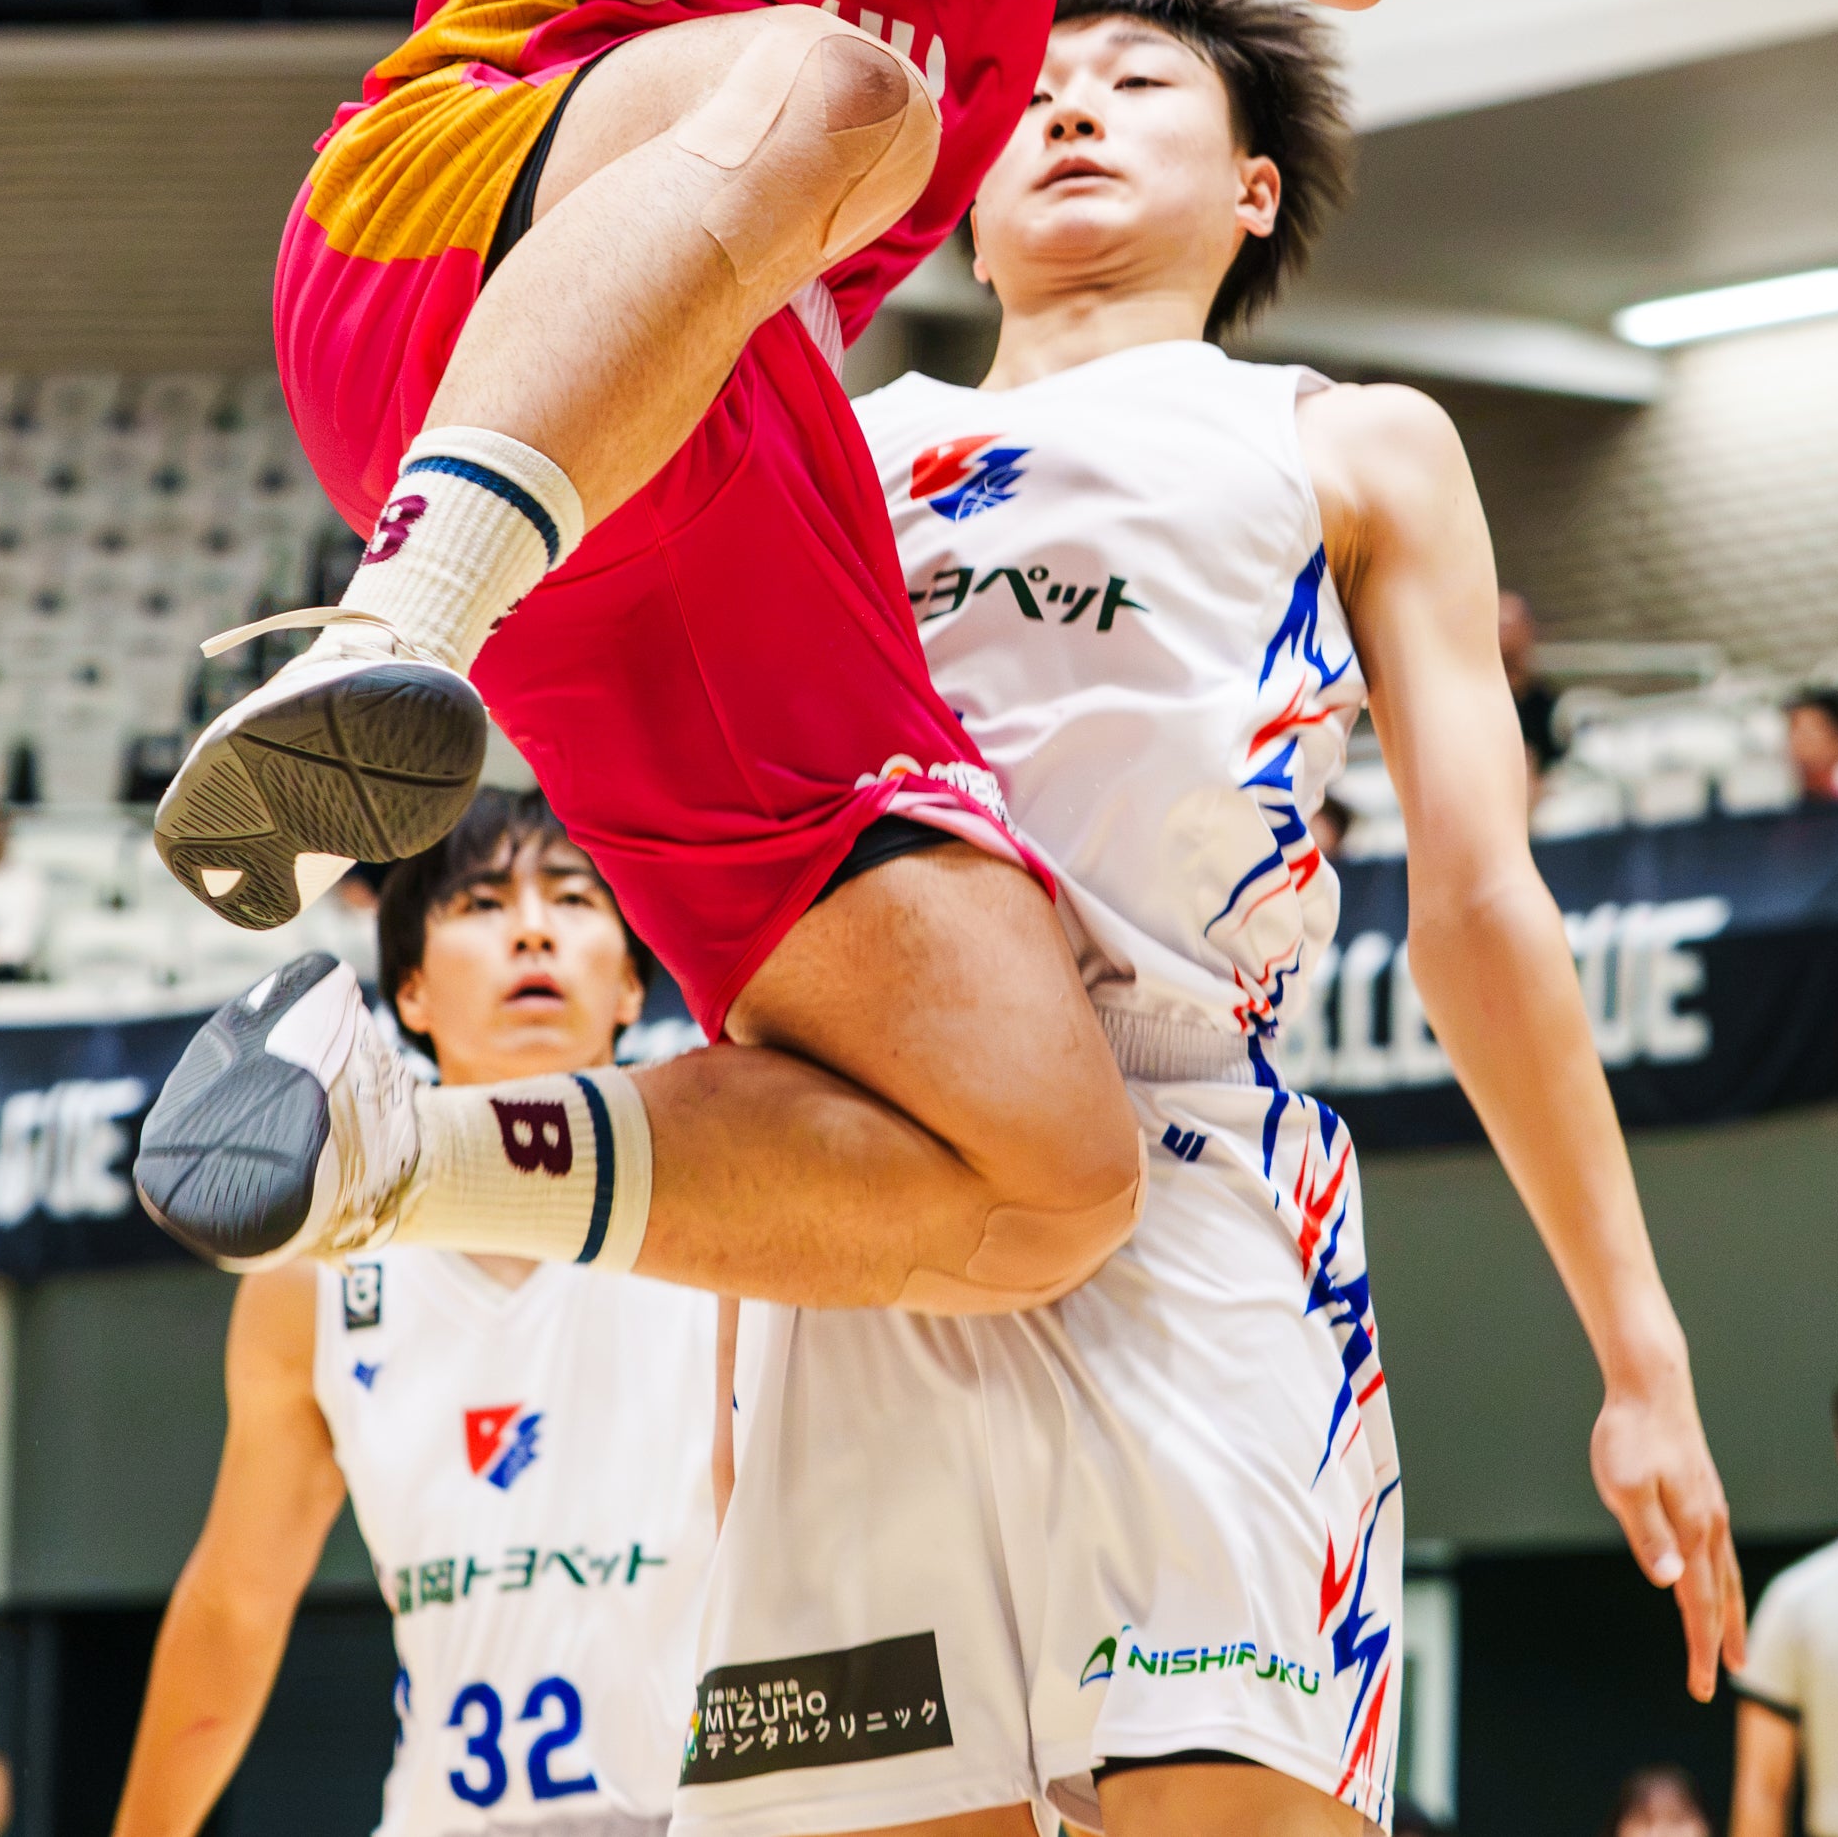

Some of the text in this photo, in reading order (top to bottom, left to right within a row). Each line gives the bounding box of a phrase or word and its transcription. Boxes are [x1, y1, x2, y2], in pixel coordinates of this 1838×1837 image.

[489, 1097, 574, 1180] B
[446, 1676, 599, 1808] 32
[705, 1689, 827, 1733] MIZUHO
[705, 1698, 938, 1759] デンタルクリニック
